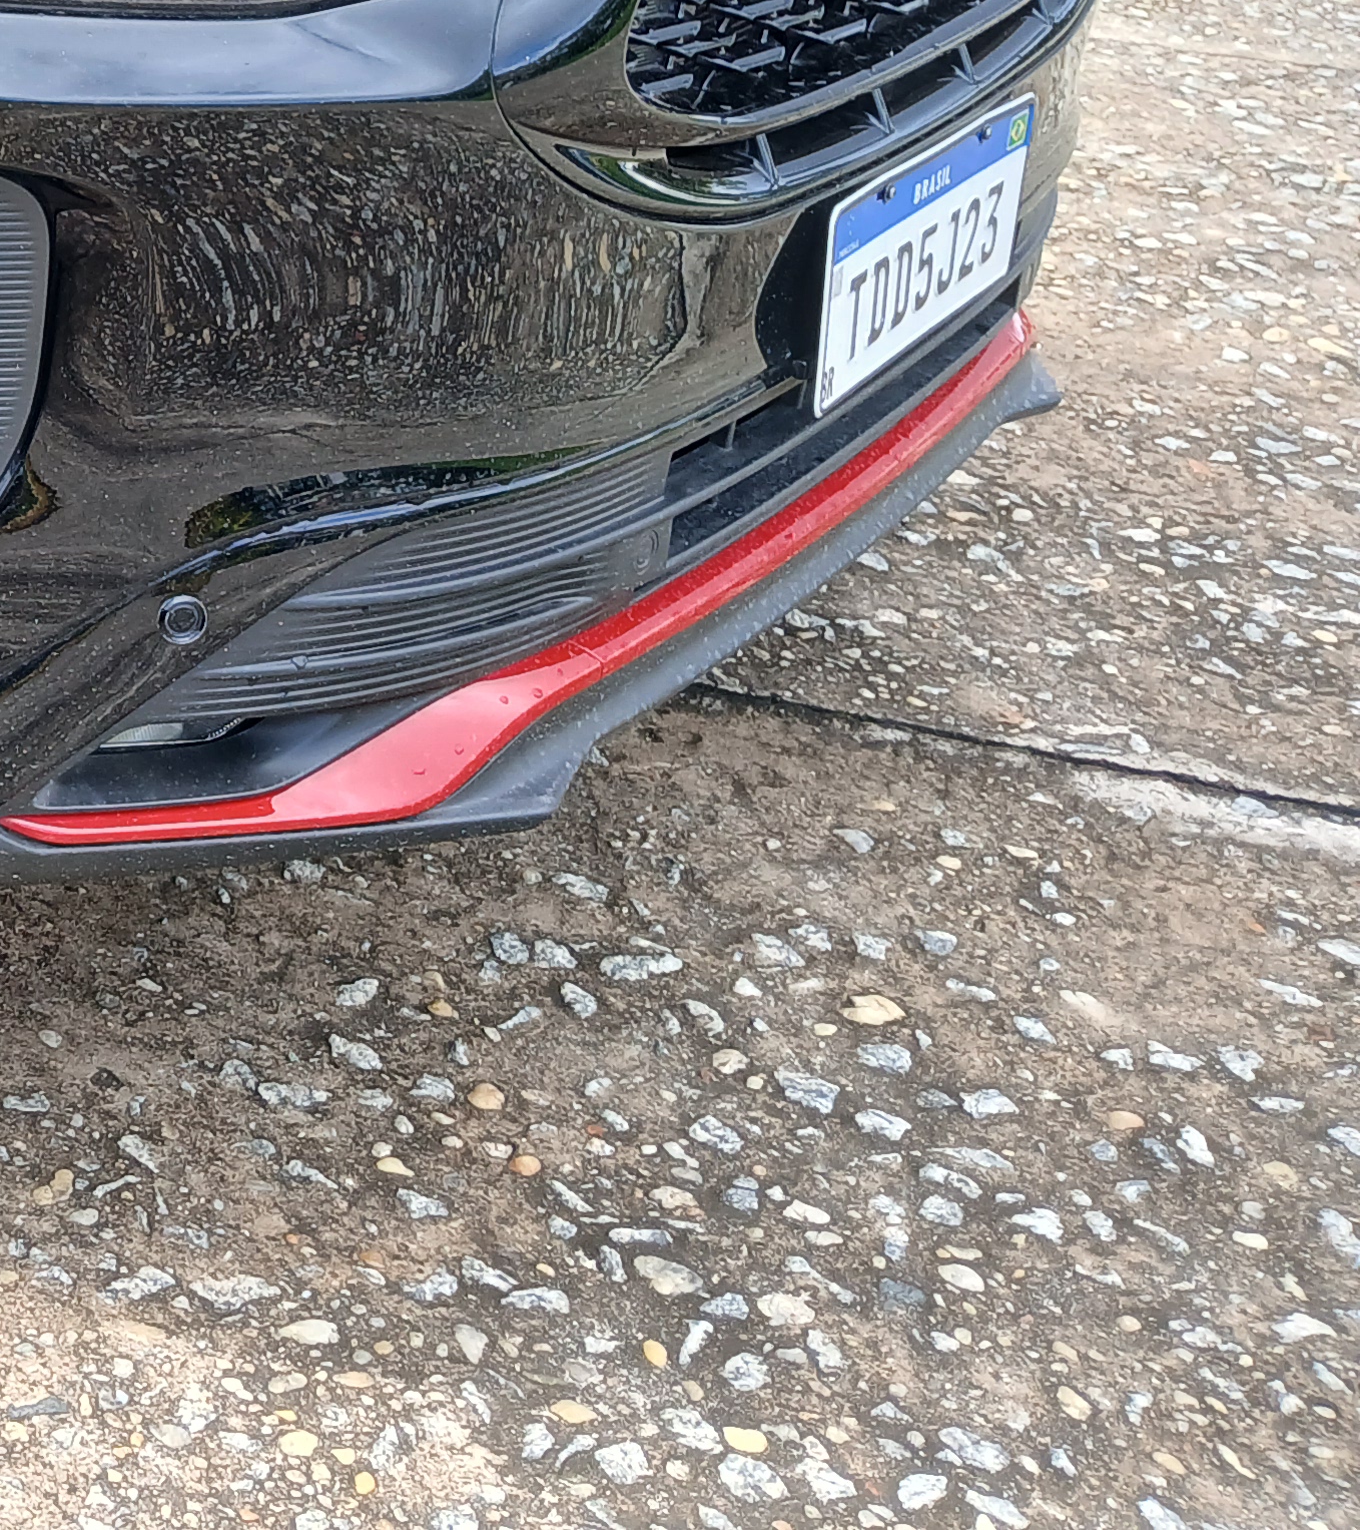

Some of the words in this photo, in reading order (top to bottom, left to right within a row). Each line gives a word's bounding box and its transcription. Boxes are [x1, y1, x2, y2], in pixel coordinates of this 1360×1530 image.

[912, 164, 952, 205] BRASIL
[847, 179, 1005, 363] TDD5J23
[819, 365, 835, 404] BR
